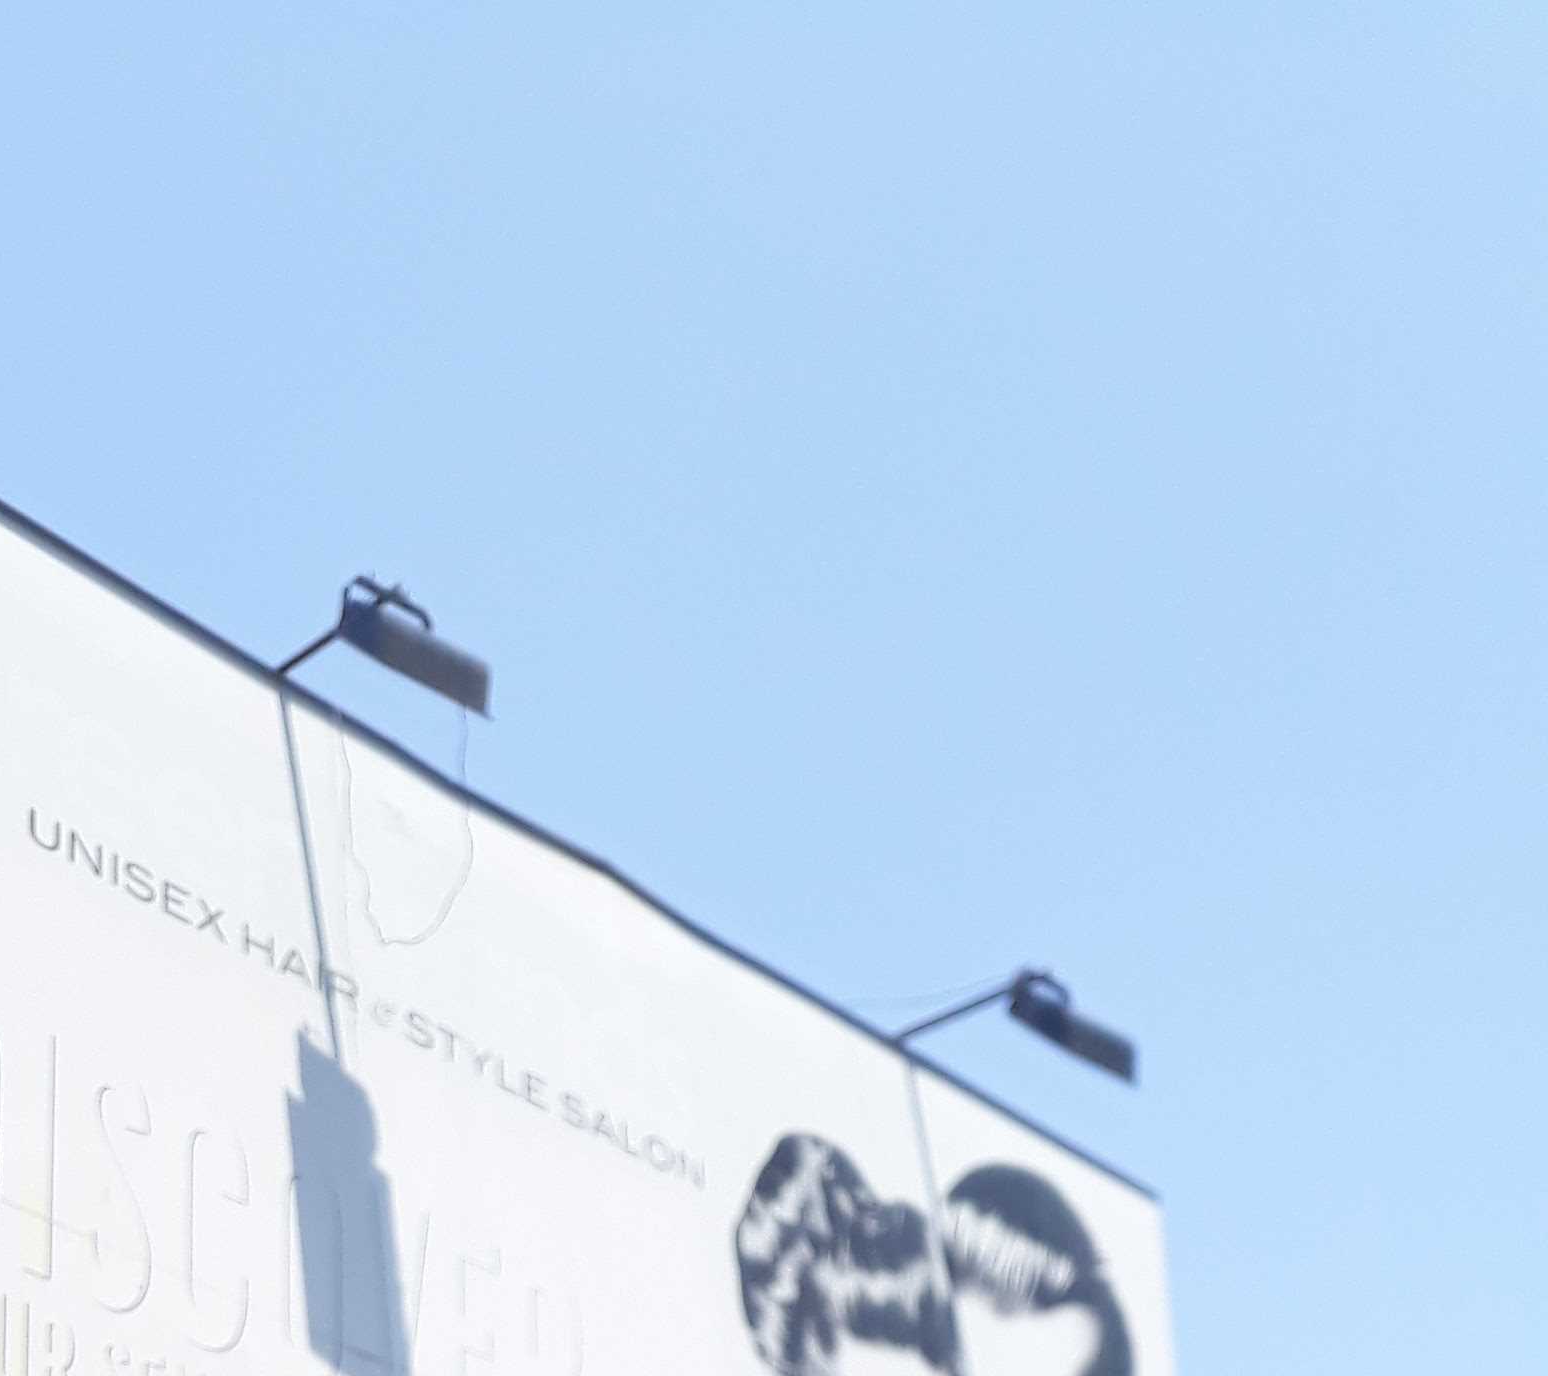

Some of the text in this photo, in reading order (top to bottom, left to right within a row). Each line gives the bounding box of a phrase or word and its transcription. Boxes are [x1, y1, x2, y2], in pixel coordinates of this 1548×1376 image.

[28, 804, 229, 945] UNISEX
[241, 921, 361, 1013] HAIR
[403, 1009, 550, 1112] STYLE
[557, 1093, 708, 1191] SALON
